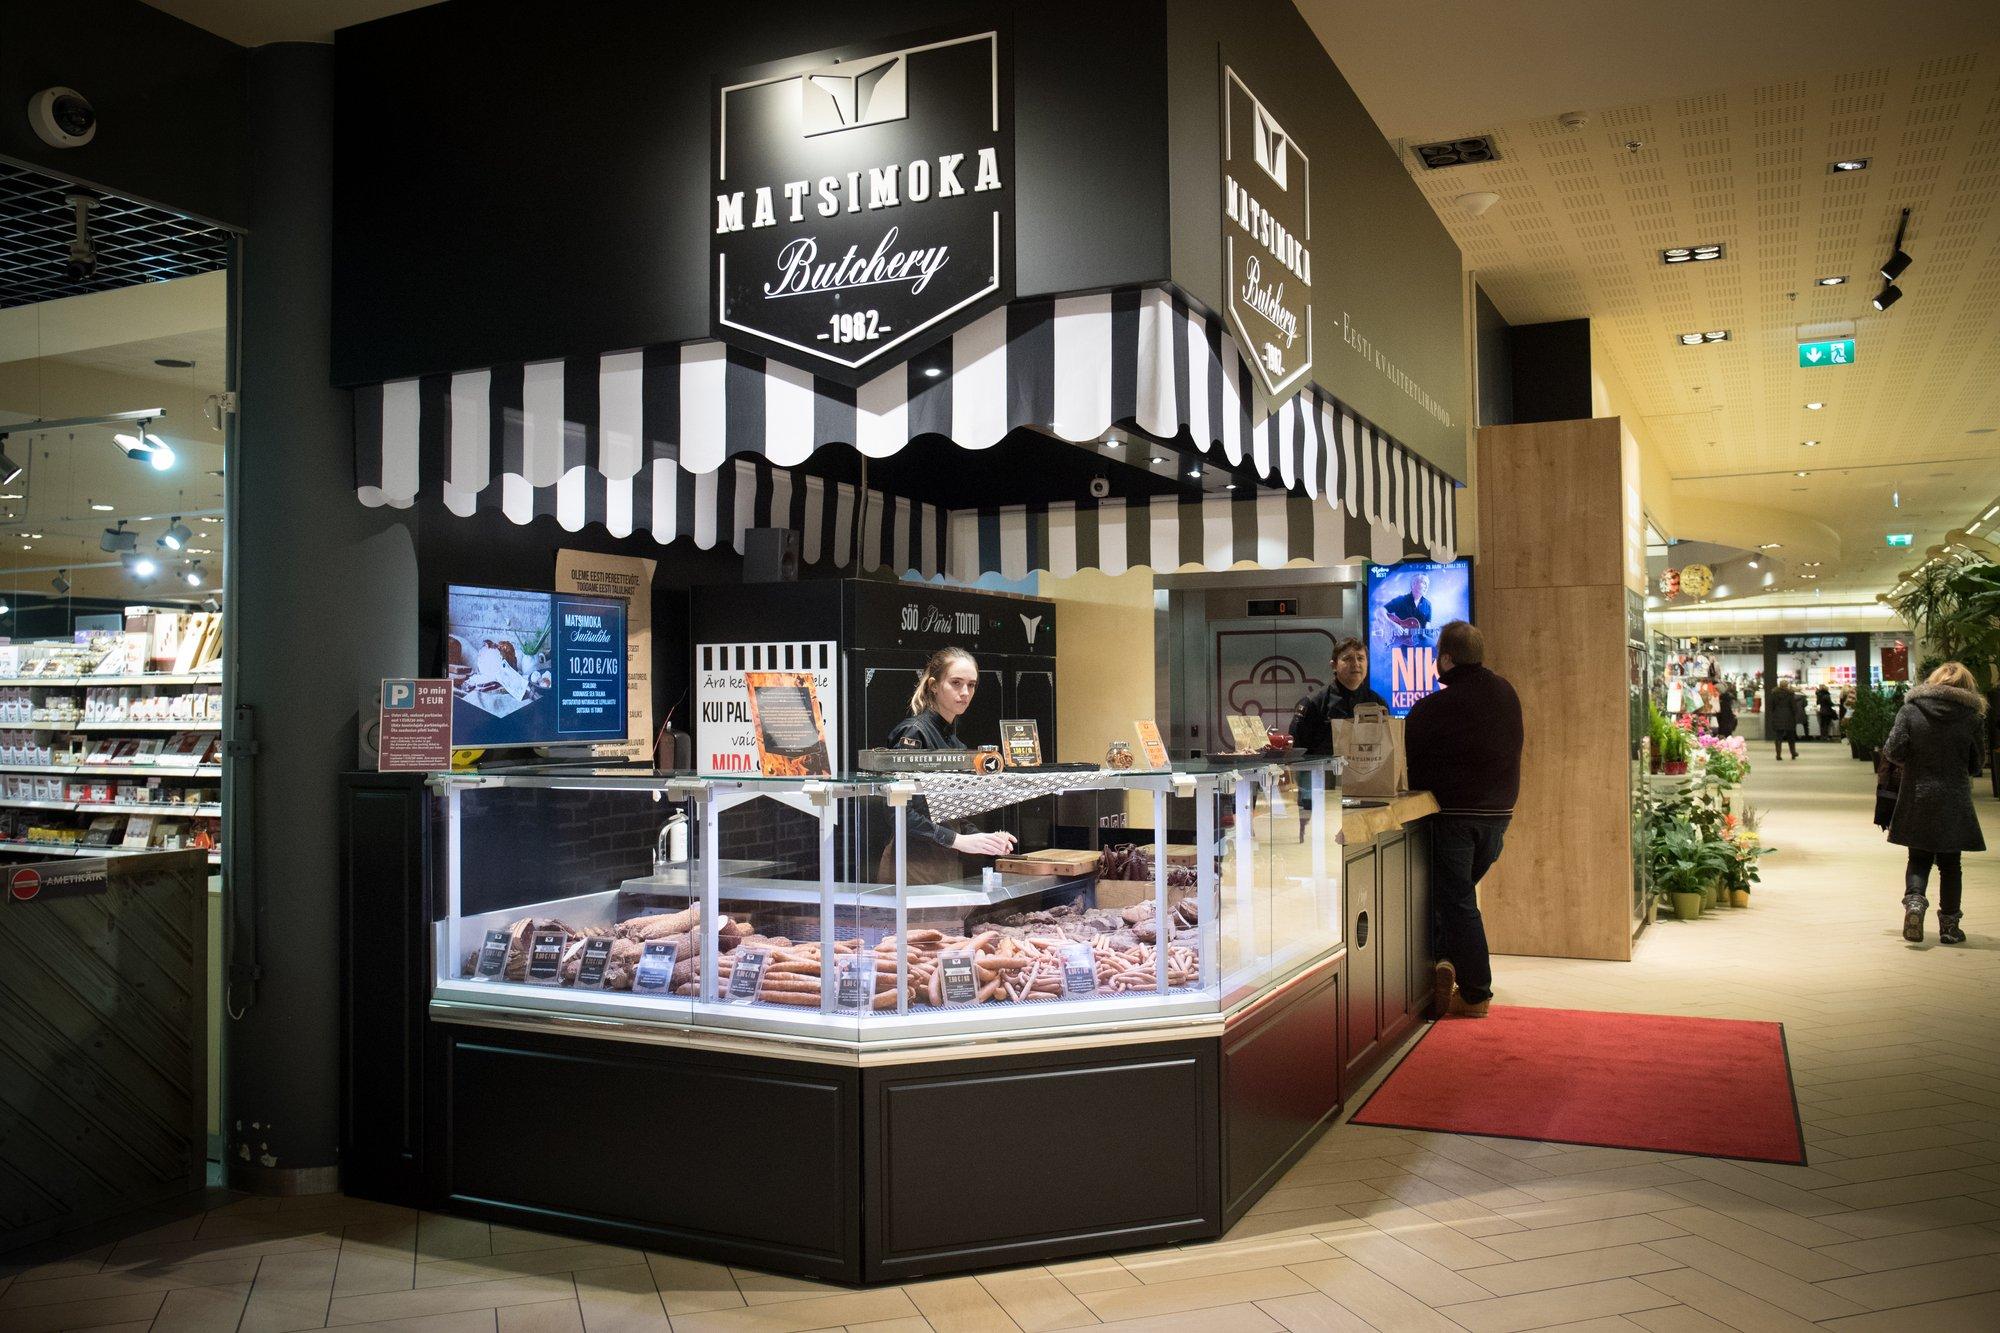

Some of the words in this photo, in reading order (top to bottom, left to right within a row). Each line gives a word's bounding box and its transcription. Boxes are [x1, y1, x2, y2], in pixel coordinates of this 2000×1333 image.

[716, 147, 1002, 234] MATSIMOKA
[1225, 174, 1312, 287] MATSIMOKA
[763, 226, 949, 297] Butchery
[1242, 255, 1298, 349] Butchery
[571, 569, 589, 581] OLEME
[590, 571, 604, 582] EESTI
[599, 583, 612, 594] EESTI
[1280, 602, 1285, 613] 0
[564, 614, 602, 628] MATSIMOKA
[901, 603, 919, 631] SÖÖ
[921, 604, 953, 634] Päris
[955, 612, 980, 635] TOITU!
[570, 629, 611, 643] Suitsuliha
[1784, 636, 1848, 648] TIGER
[569, 657, 594, 676] 10,20
[703, 674, 726, 689] Ära
[418, 687, 428, 695] 30
[430, 686, 447, 695] min
[420, 697, 425, 705] 1
[427, 696, 444, 705] EUR
[703, 701, 723, 722] KUI
